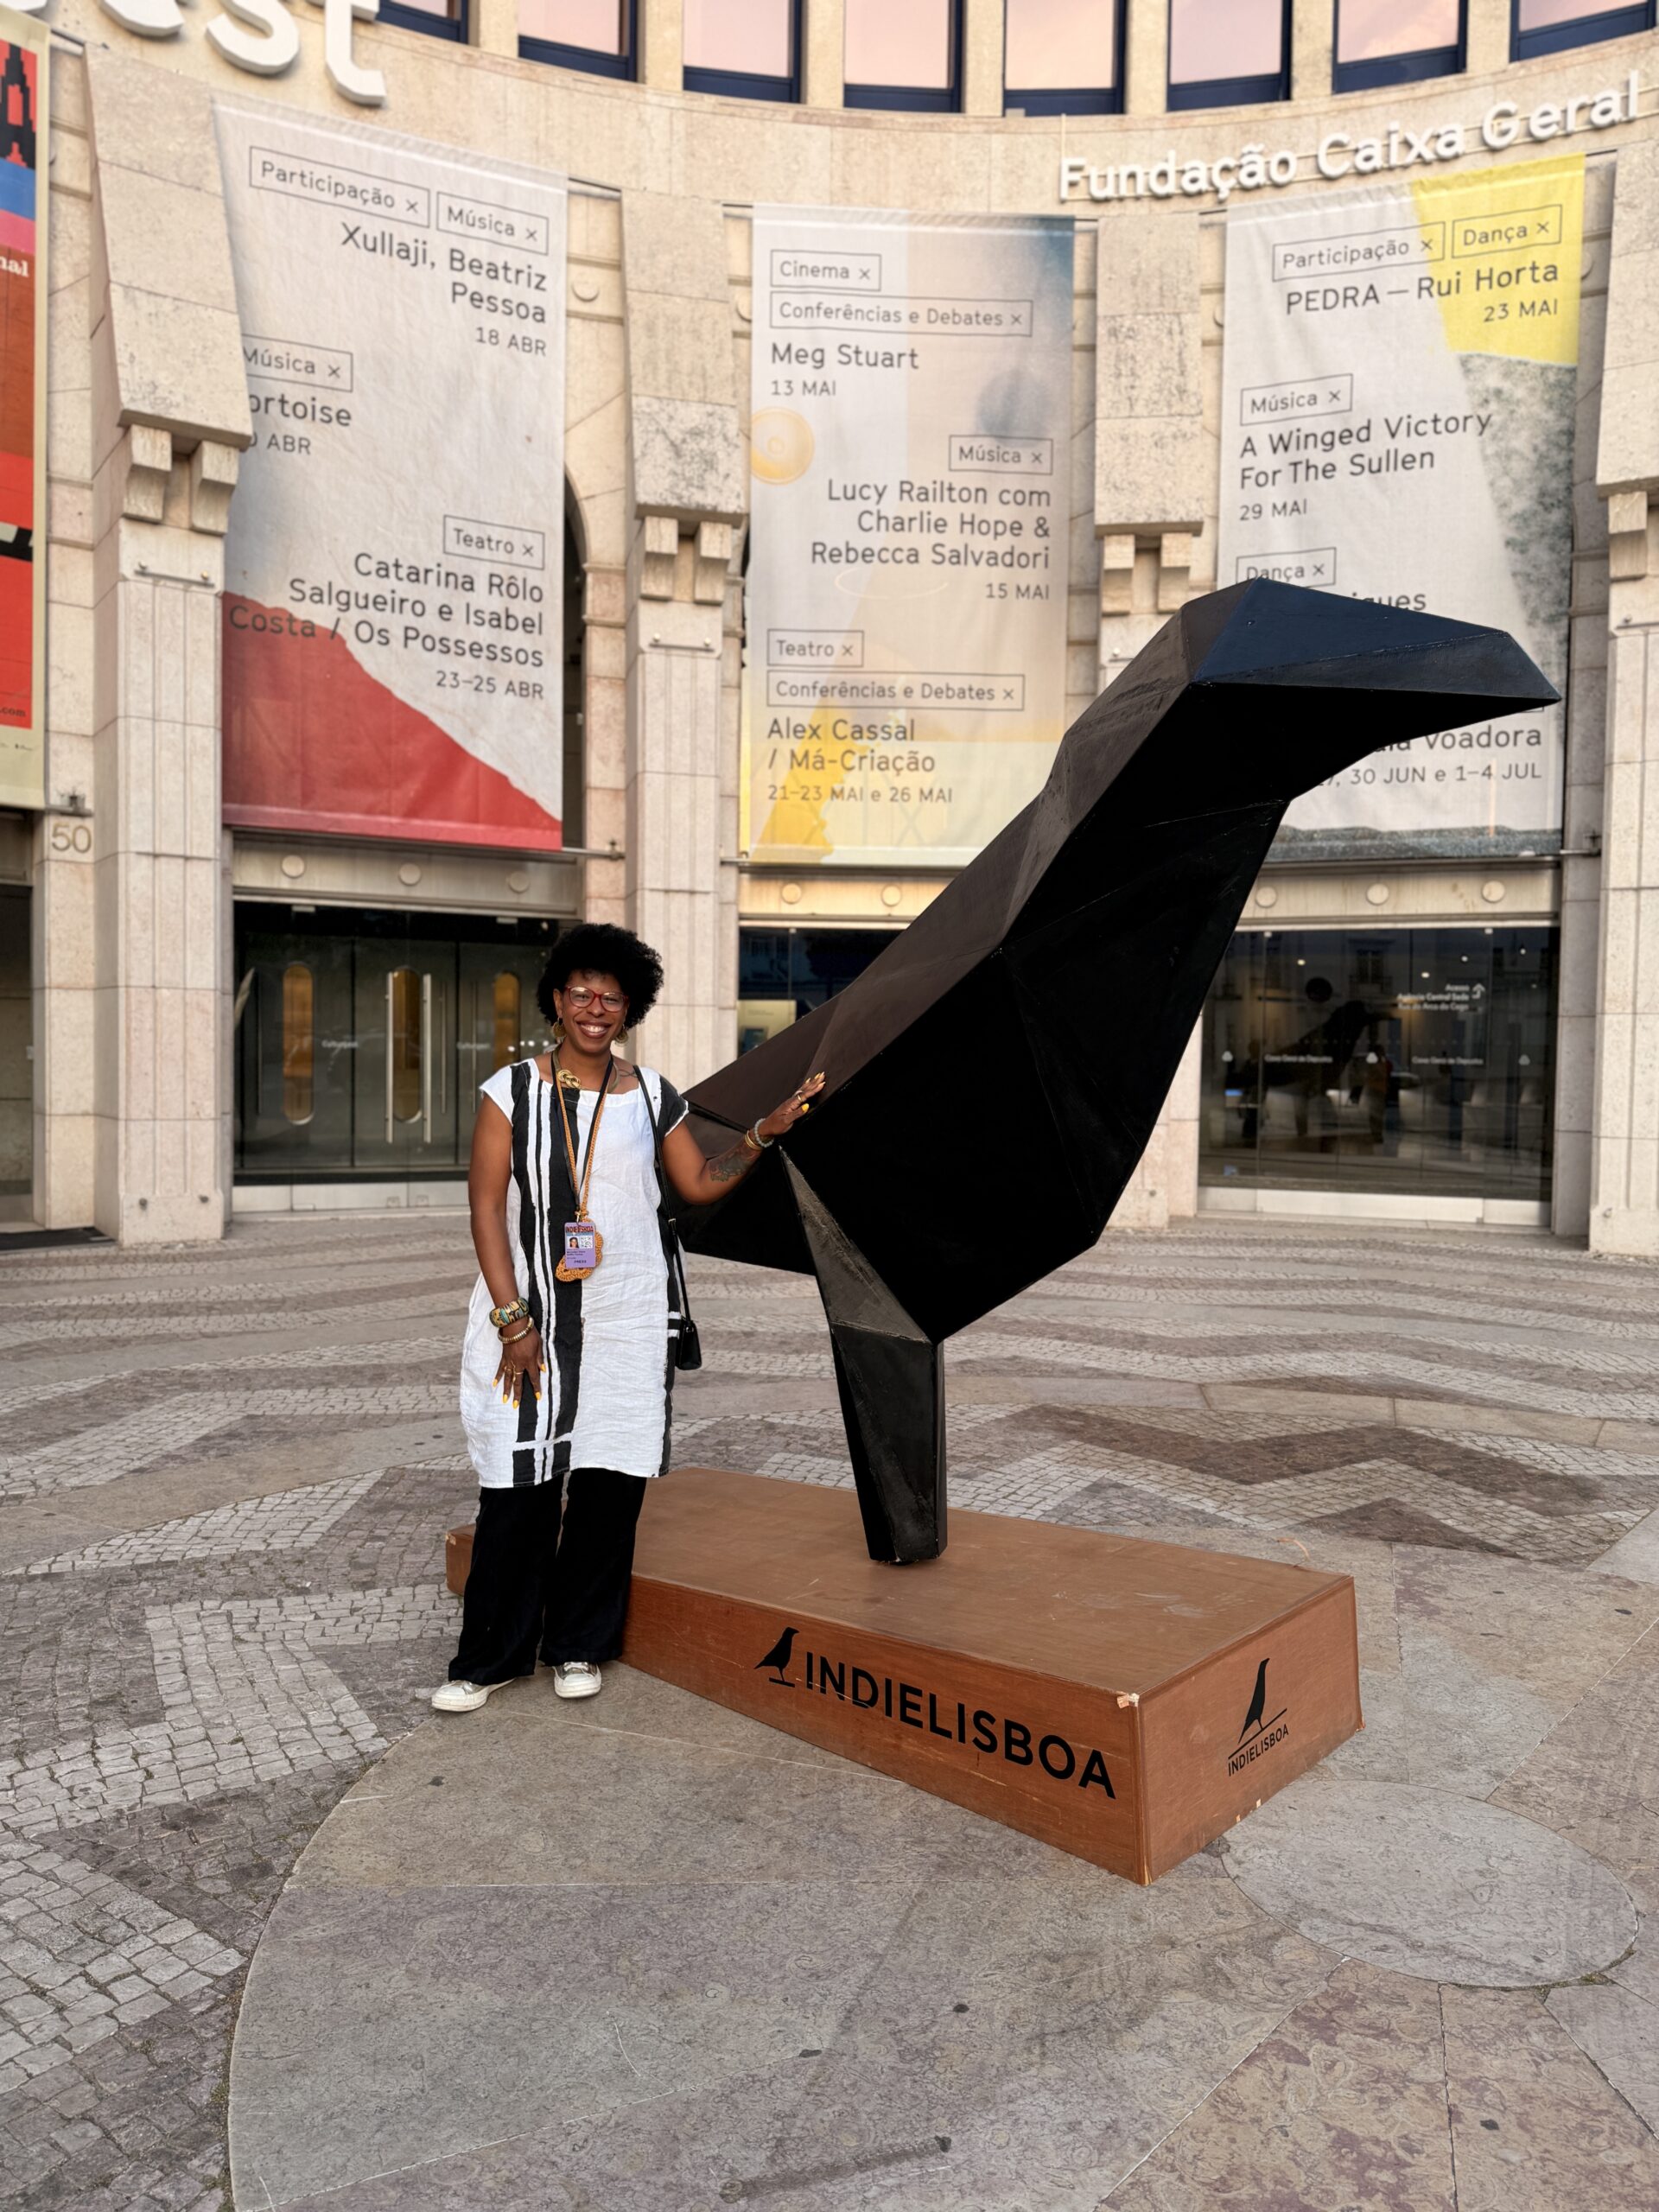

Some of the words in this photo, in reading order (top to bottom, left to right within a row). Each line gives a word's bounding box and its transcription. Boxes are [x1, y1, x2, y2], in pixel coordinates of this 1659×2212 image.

[1059, 143, 1296, 204] Fundação
[1318, 122, 1466, 180] Caixa
[1482, 69, 1639, 150] Geral
[261, 161, 396, 208] Participação
[447, 206, 515, 237] Música
[1463, 225, 1528, 246] Dança
[340, 221, 435, 270] Xullaji,
[449, 247, 547, 292] Beatriz
[1282, 239, 1409, 269] Participação
[779, 260, 850, 280] Cinema
[1418, 271, 1461, 300] Rui
[1476, 261, 1559, 292] Horta
[452, 281, 546, 324] Pessoa
[779, 302, 902, 323] Conferências
[908, 310, 919, 324] e
[926, 308, 1003, 327] Debates
[1484, 303, 1509, 323] 23
[1519, 298, 1558, 319] MAI
[476, 326, 500, 346] 18
[507, 334, 547, 357] ABR
[243, 346, 316, 374] Música
[771, 342, 825, 369] Meg
[837, 344, 919, 370] Stuart
[771, 380, 794, 397] 13
[802, 380, 836, 397] MAI
[1252, 391, 1318, 414] Música
[248, 393, 352, 427] ortoise
[266, 433, 312, 455] ABR
[1240, 435, 1257, 458] A
[1268, 418, 1370, 455] Winged
[1384, 412, 1492, 439] Victory
[958, 443, 1021, 464] Música
[1240, 467, 1281, 489] For
[1288, 458, 1337, 483] The
[1349, 448, 1434, 476] Sullen
[828, 479, 887, 505] Lucy
[899, 480, 988, 505] Railton
[998, 486, 1051, 507] com
[1239, 504, 1262, 521] 29
[1272, 498, 1308, 518] MAI
[857, 510, 948, 534] Charlie
[960, 512, 1023, 540] Hope
[1033, 516, 1051, 538] &
[453, 527, 515, 555] Teatro
[811, 542, 920, 565] Rebecca
[931, 542, 1049, 569] Salvadori
[354, 552, 475, 593] Catarina
[488, 573, 543, 603] Rôlo
[985, 582, 1007, 600] 15
[1015, 583, 1050, 601] MAI
[289, 577, 426, 618] Salgueiro
[438, 603, 454, 622] e
[466, 601, 543, 636] Isabel
[229, 605, 316, 638] Costa
[329, 617, 340, 640] /
[354, 620, 391, 646] Os
[404, 626, 543, 668] Possessos
[775, 639, 835, 658] Teatro
[505, 679, 543, 700] ABR
[775, 680, 896, 699] Conferências
[903, 685, 914, 699] e
[921, 683, 995, 701] Debates
[767, 716, 822, 741] Alex
[832, 718, 915, 741] Cassal
[768, 748, 777, 771] /
[789, 747, 936, 776] Má-Criação
[1350, 767, 1376, 785] 30
[1382, 766, 1426, 784] JUN
[1434, 769, 1446, 782] e
[1503, 762, 1541, 780] JUL
[830, 785, 863, 803] MAI
[871, 791, 881, 803] e
[888, 785, 911, 804] 26
[918, 786, 952, 804] MAI
[51, 822, 92, 854] 50
[806, 1651, 1116, 1800] INDIELISBOA
[1228, 1723, 1289, 1777] INDIELISBOA
